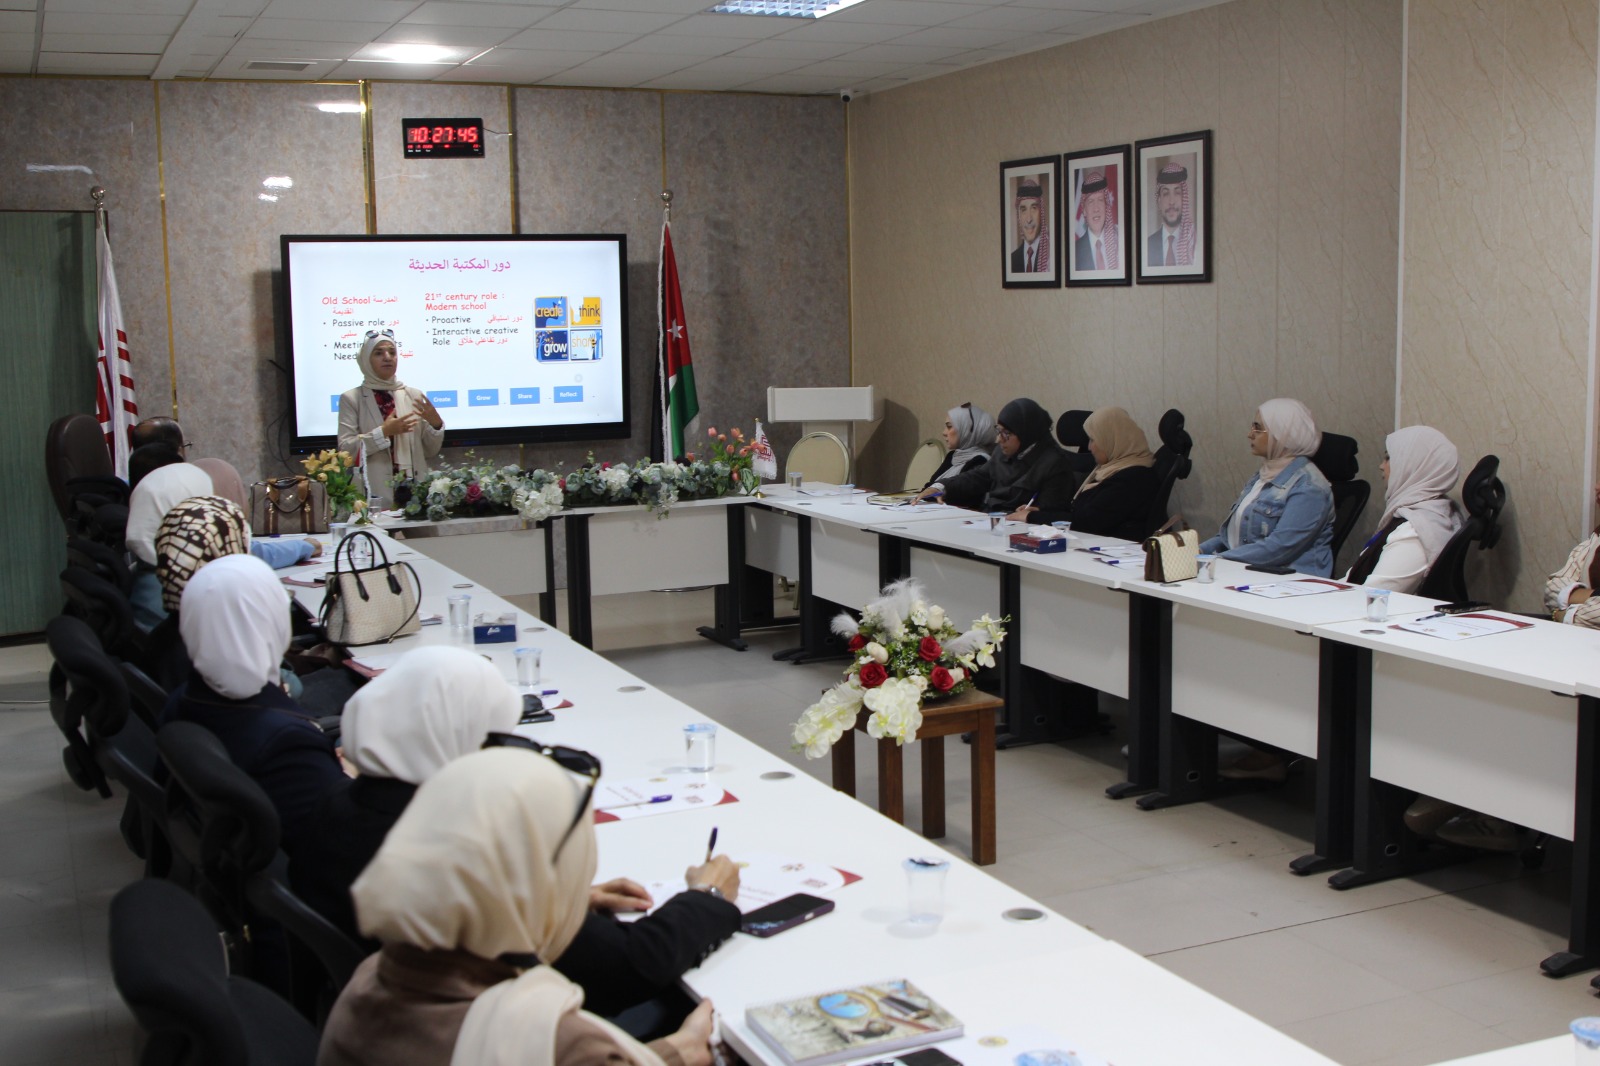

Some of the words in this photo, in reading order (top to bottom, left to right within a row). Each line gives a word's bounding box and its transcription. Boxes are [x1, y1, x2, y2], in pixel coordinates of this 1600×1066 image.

[409, 126, 478, 143] 10:27:45
[408, 258, 449, 273] الحديثة
[452, 257, 490, 272] المكتبة
[491, 260, 511, 272] دور
[322, 296, 338, 305] Old
[341, 296, 371, 305] School
[445, 292, 478, 302] century
[481, 292, 498, 300] role
[425, 303, 458, 311] Modern
[461, 302, 487, 310] school
[536, 305, 564, 318] create
[579, 304, 601, 318] think
[332, 319, 365, 327] Passive
[368, 318, 385, 326] role
[431, 315, 472, 324] Proactive
[432, 327, 481, 336] Interactive
[484, 326, 519, 335] creative
[334, 341, 365, 350] Meetin
[432, 337, 451, 346] Role
[543, 343, 568, 357] grow
